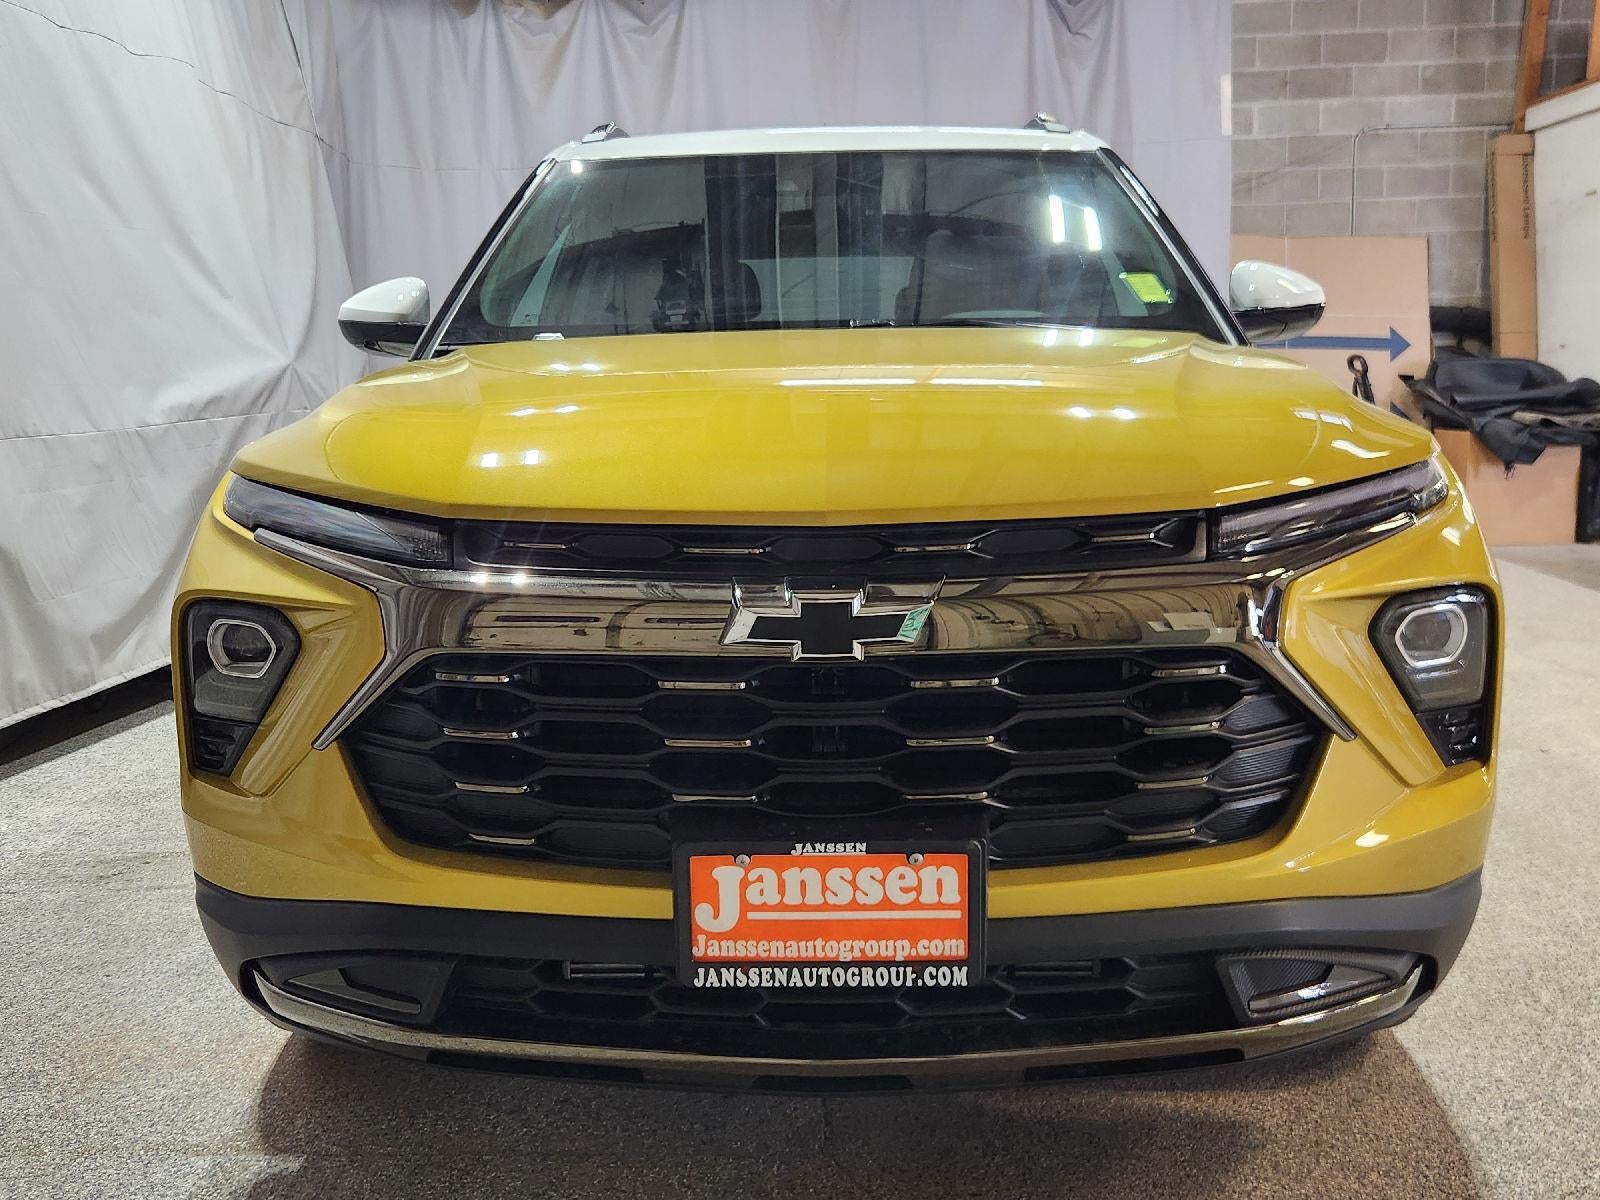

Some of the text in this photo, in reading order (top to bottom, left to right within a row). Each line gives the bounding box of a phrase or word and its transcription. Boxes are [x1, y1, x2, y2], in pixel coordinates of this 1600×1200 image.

[791, 842, 866, 856] JANSSEN
[695, 865, 961, 933] Janssen
[692, 934, 965, 961] Janssenautogroup.com
[693, 966, 968, 987] JANSSENAUTOGROUP.COM
